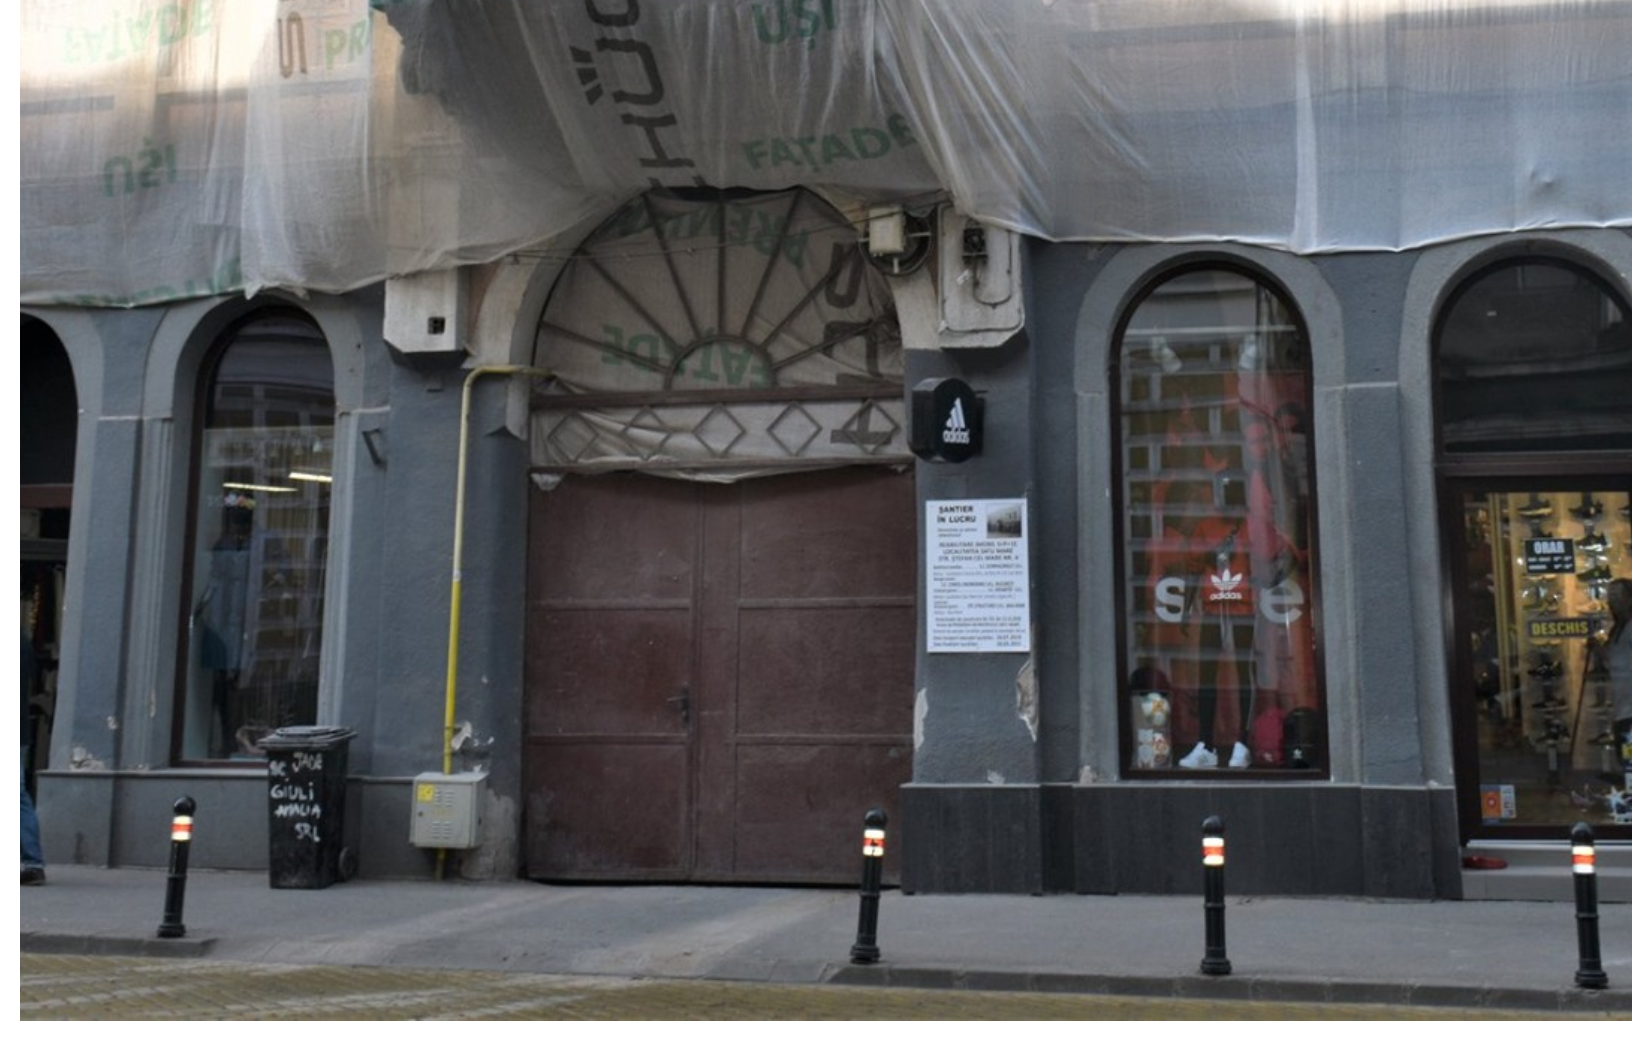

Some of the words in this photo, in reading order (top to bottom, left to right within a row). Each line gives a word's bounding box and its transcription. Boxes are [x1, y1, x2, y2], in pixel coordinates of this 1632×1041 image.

[942, 427, 970, 445] adidas
[948, 515, 977, 523] LUCRU
[1533, 541, 1565, 555] ORAR
[1154, 576, 1304, 624] se
[1209, 591, 1243, 601] adidas
[1531, 620, 1589, 636] DESCHIS
